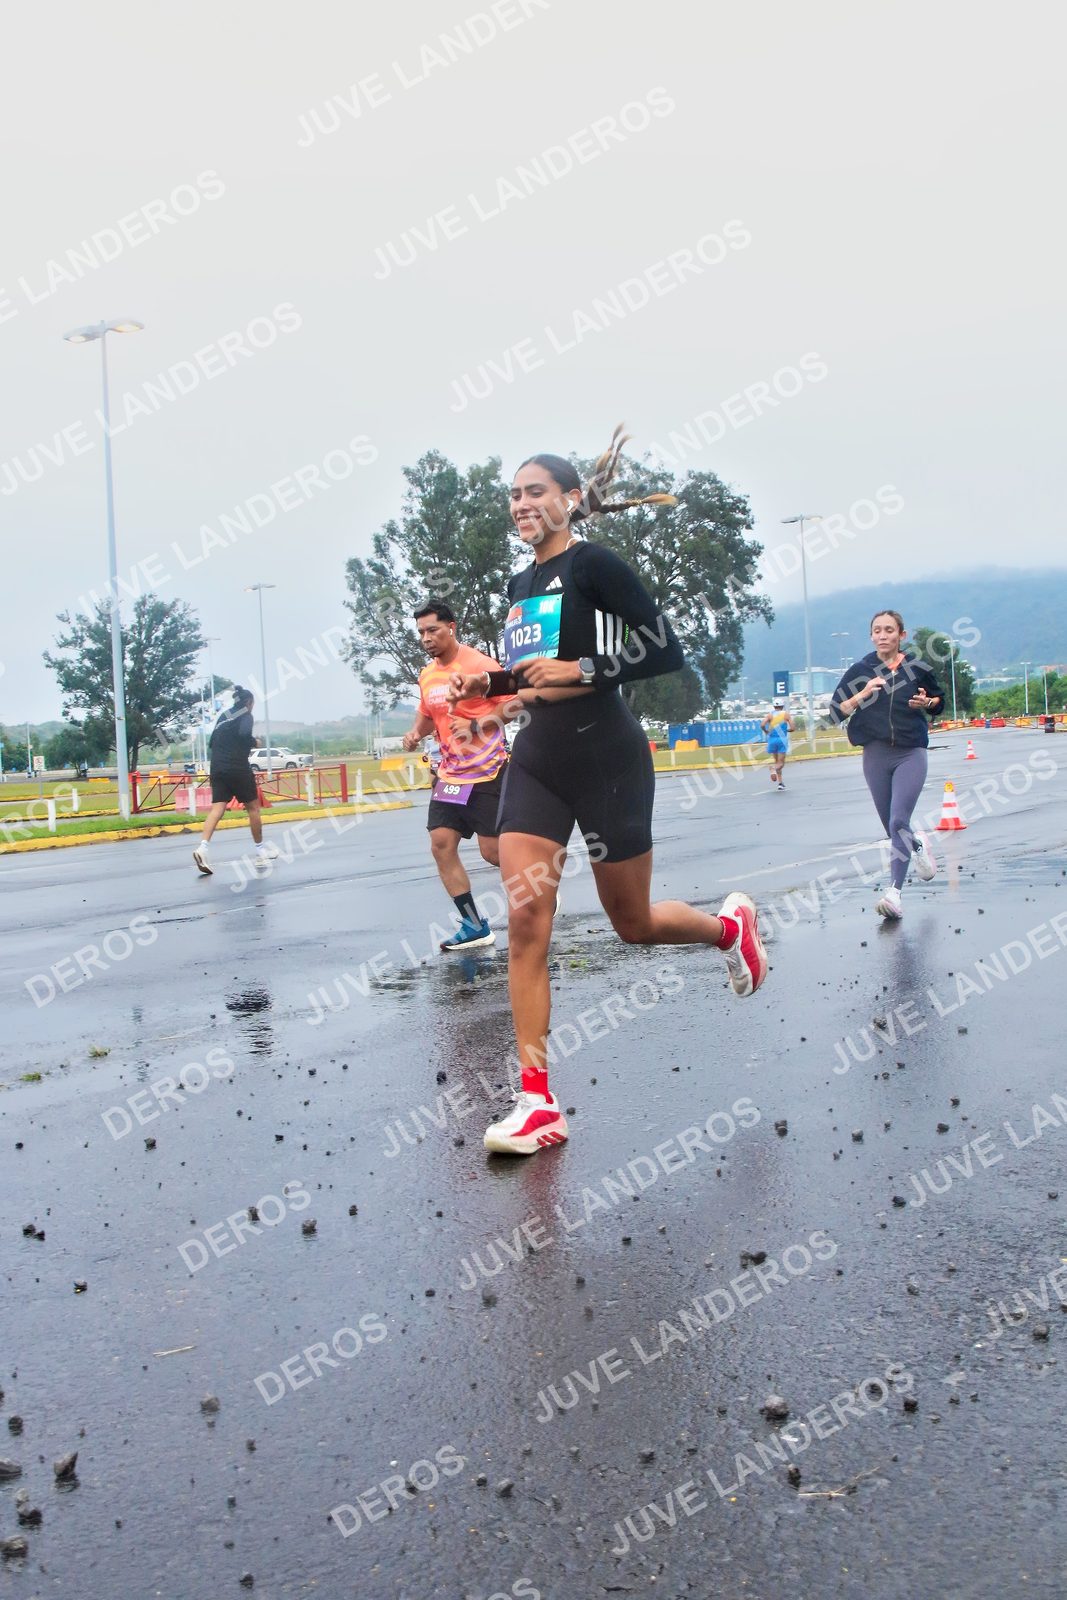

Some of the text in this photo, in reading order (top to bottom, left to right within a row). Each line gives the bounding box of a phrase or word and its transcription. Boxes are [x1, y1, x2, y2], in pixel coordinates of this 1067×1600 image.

[510, 623, 542, 649] 1023
[776, 681, 786, 694] E
[443, 784, 461, 795] 499
